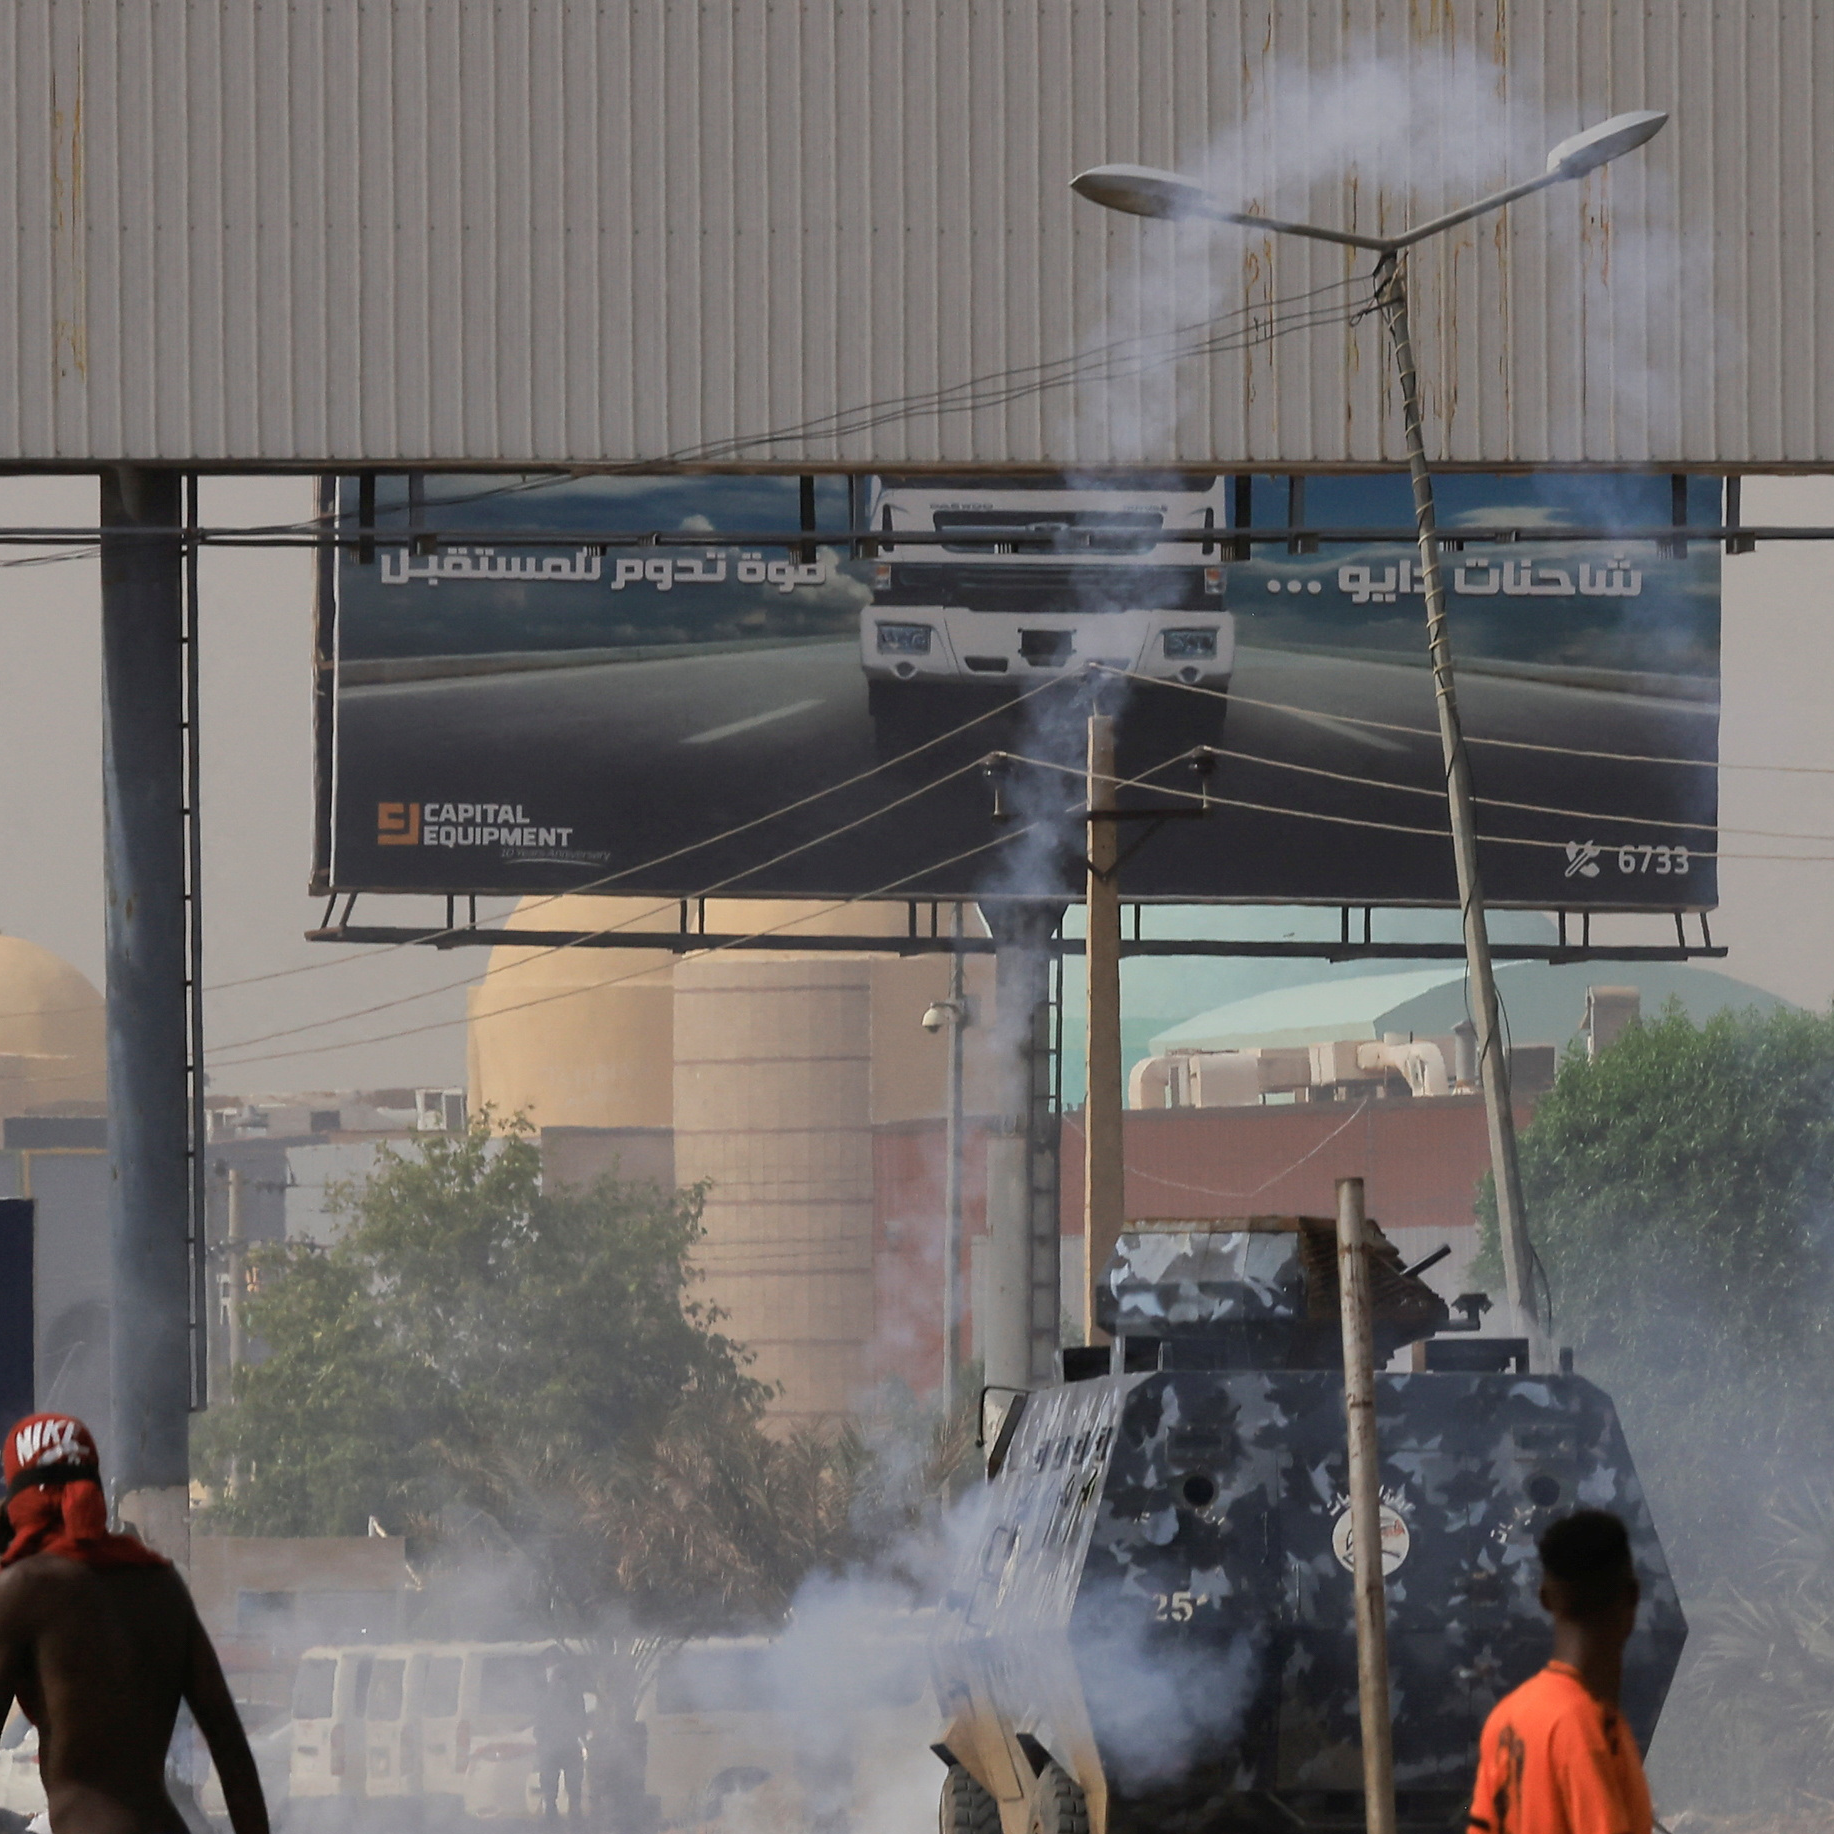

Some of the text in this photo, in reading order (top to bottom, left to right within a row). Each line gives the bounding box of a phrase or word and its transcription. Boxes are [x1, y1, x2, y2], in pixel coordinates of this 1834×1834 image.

[381, 547, 601, 586] للمستقبل
[611, 551, 726, 591] تدوم
[1454, 551, 1642, 596] شاحنات
[423, 803, 531, 825] CAPITAL
[423, 825, 574, 848] EQUIPMENT
[1618, 845, 1690, 876] 6733
